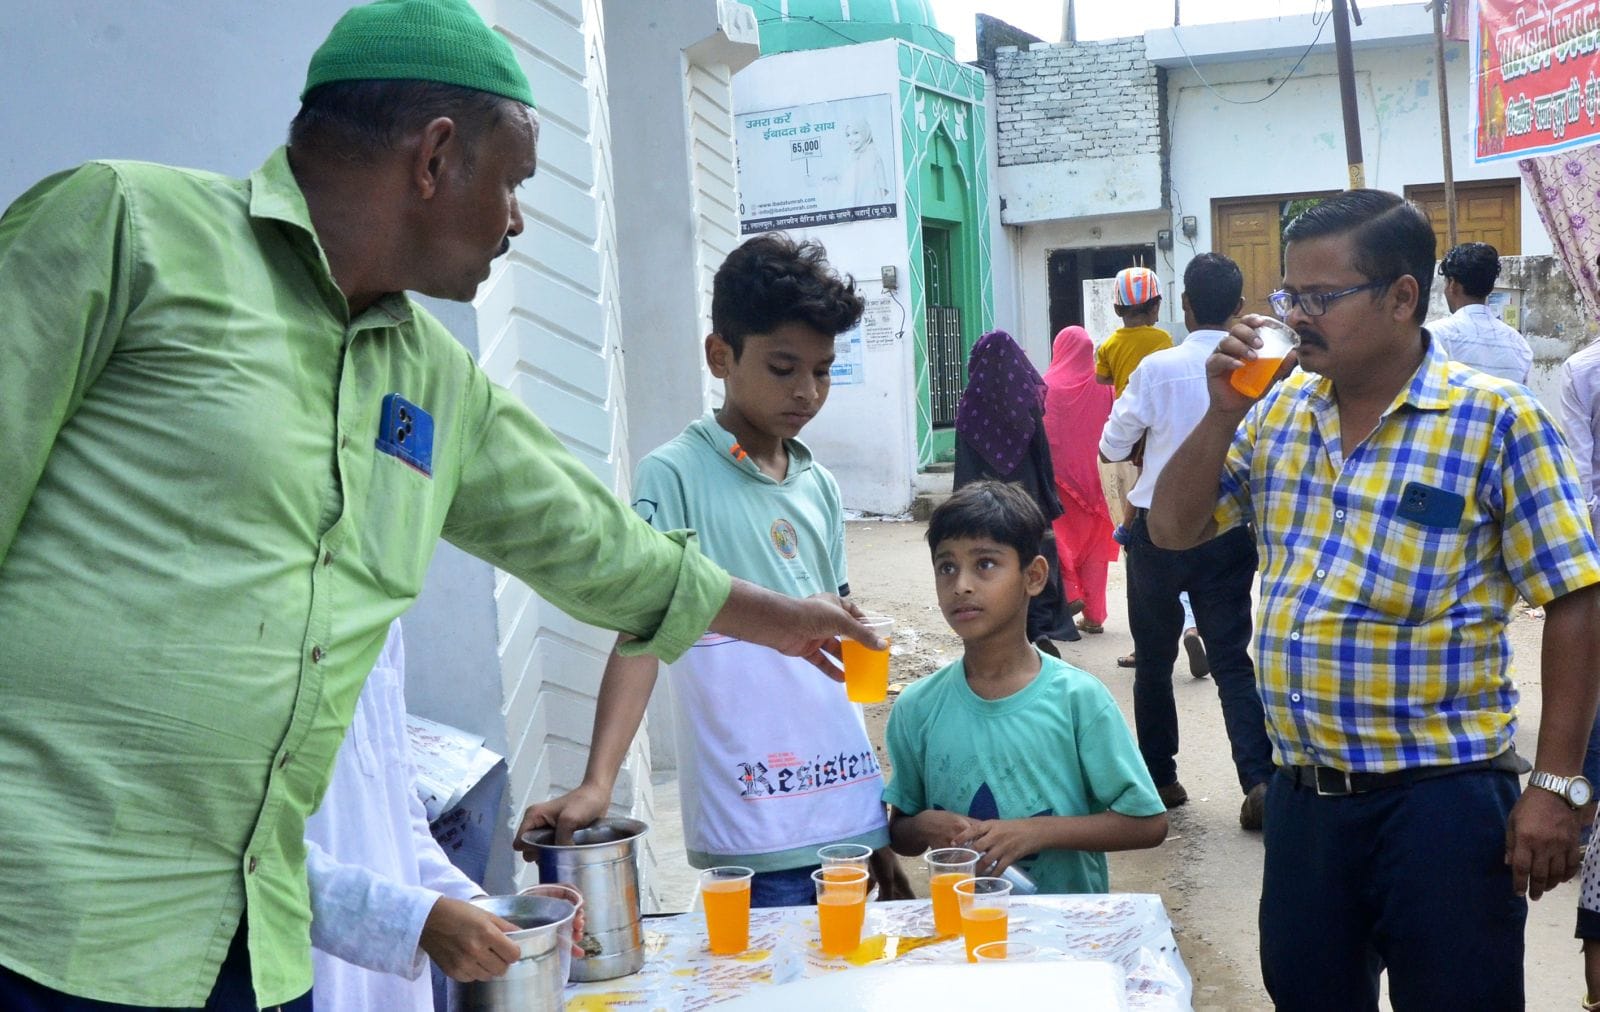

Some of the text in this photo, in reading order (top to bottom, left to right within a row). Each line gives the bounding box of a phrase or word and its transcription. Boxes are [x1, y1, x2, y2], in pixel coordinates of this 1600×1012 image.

[745, 112, 792, 129] उमरा करें
[763, 121, 835, 140] ईबादत के साथ
[792, 140, 819, 153] 65,000
